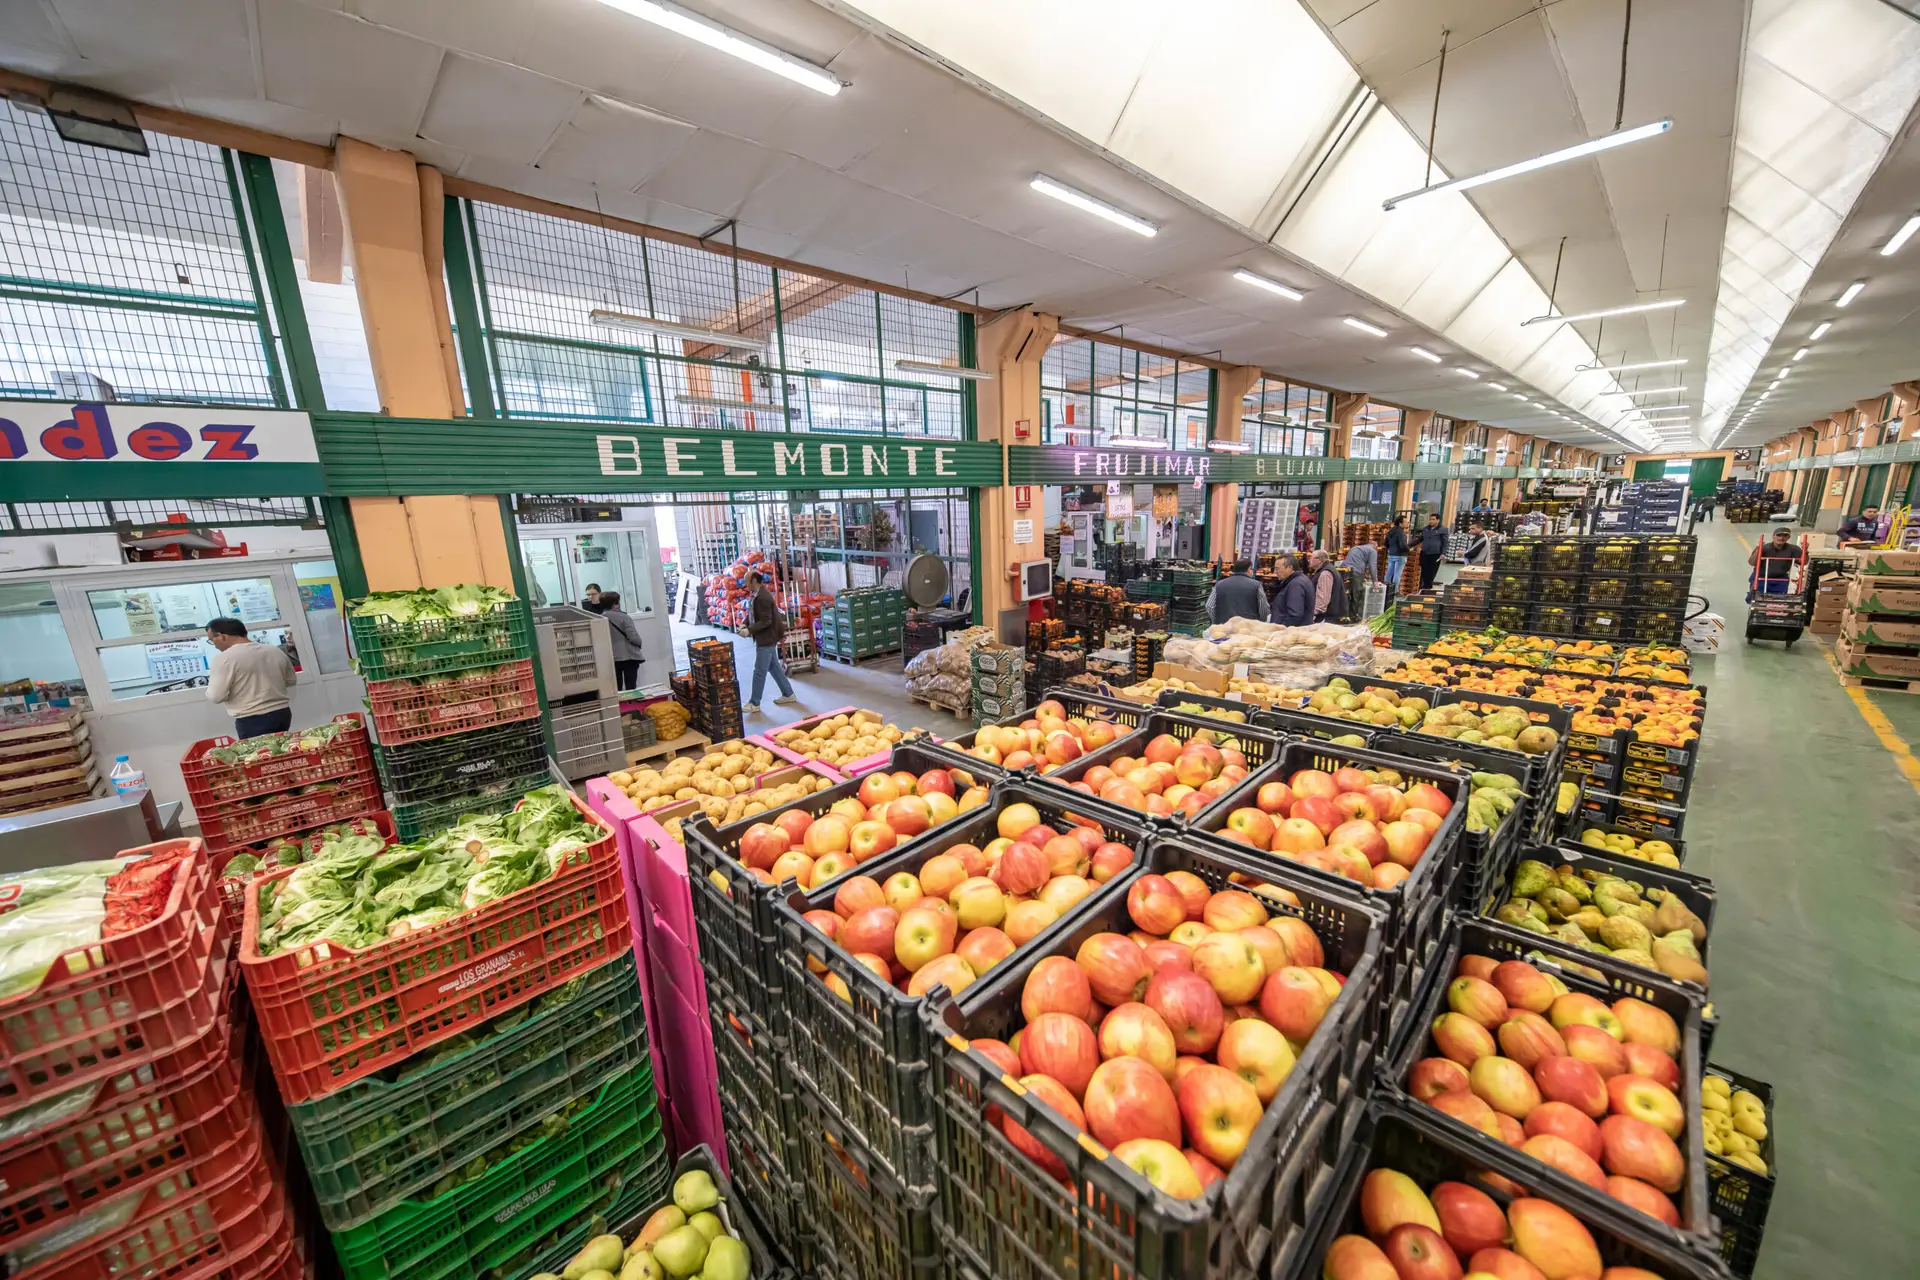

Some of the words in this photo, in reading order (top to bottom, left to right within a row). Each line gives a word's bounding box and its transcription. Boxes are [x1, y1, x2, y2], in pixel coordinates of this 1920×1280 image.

[596, 435, 957, 476] BELMONTE
[1074, 452, 1210, 475] FRUJIMAR
[459, 970, 474, 983] LOS
